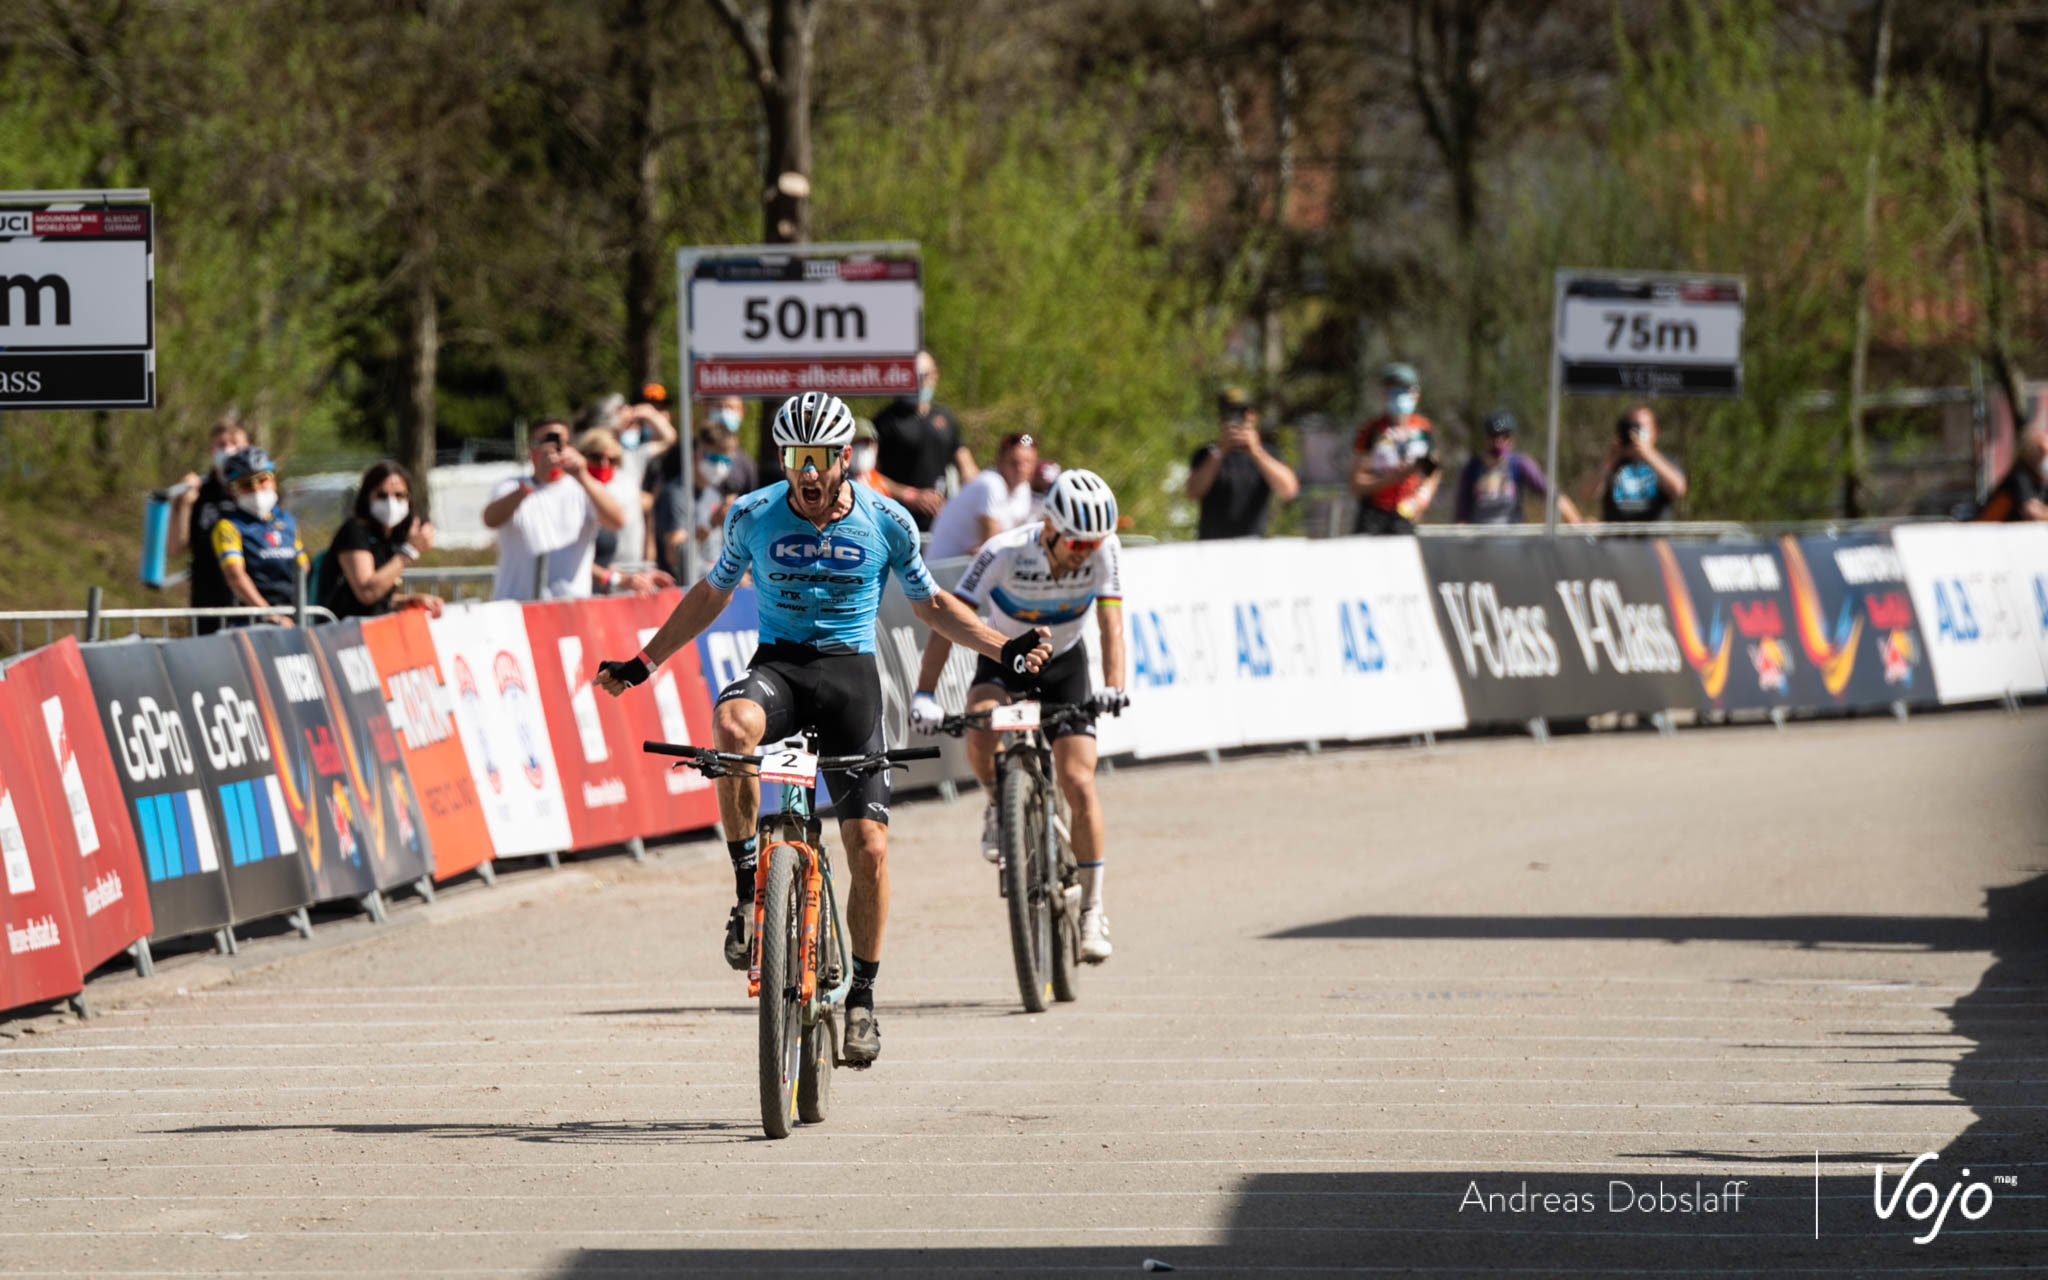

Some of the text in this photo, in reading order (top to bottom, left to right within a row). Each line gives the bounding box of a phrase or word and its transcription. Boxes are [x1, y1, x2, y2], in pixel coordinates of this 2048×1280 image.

[35, 224, 83, 232] WORLD CUP
[80, 214, 98, 223] BIKE
[744, 296, 866, 339] 50m
[1603, 313, 1698, 350] 75m
[776, 543, 860, 561] KMC
[768, 572, 864, 585] ORBEA
[1438, 581, 1560, 679] V-Class
[1555, 578, 1682, 674] V-Class
[111, 696, 194, 782] GoPro
[191, 686, 270, 770] GoPro
[781, 753, 798, 768] 2
